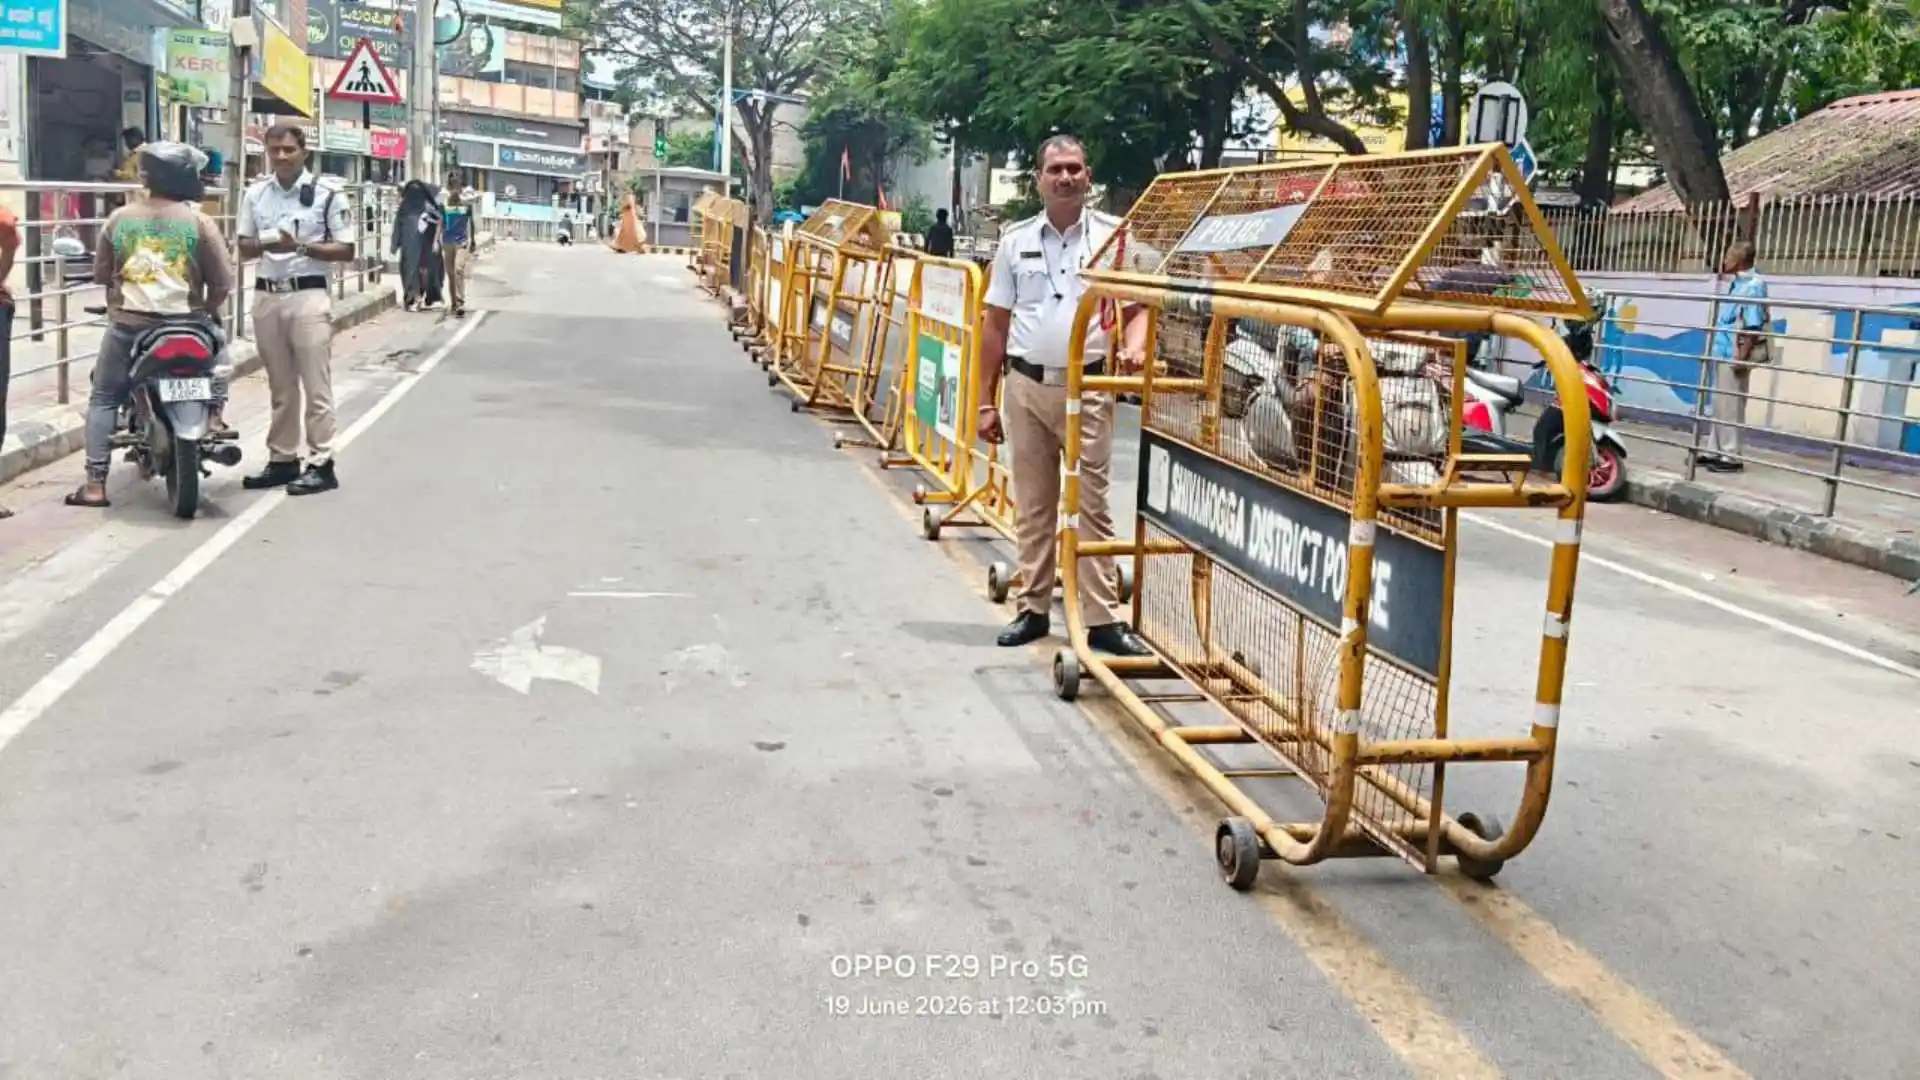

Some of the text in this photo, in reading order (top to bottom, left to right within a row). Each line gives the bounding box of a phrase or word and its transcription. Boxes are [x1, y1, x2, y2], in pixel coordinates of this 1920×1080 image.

[1198, 218, 1273, 244] POLICE
[1248, 502, 1323, 588] DISTRICT
[1321, 535, 1392, 631] POE
